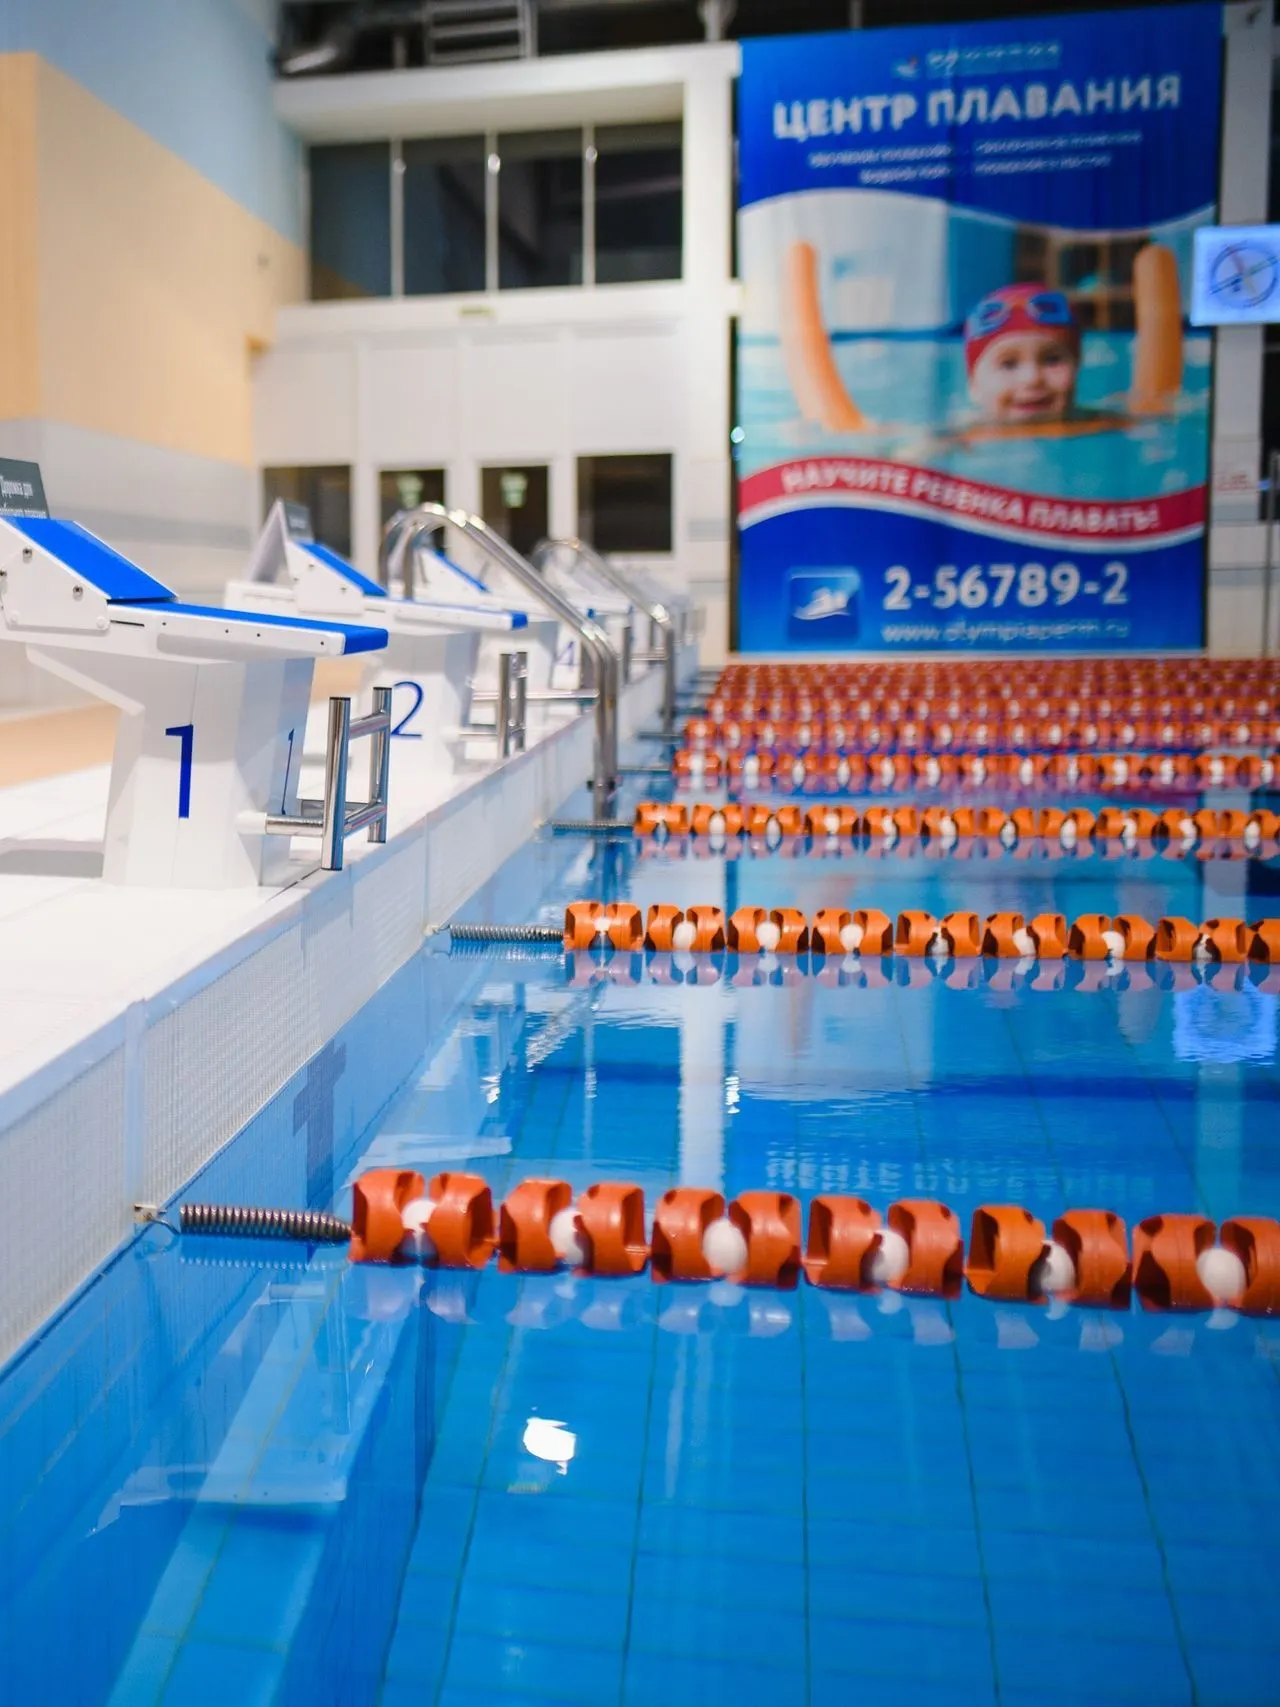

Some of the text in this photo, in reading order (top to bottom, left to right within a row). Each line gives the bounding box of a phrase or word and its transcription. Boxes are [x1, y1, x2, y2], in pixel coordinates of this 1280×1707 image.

[773, 92, 917, 142] ЦЕНТР
[926, 73, 1182, 127] ПЛАВАНИЯ
[781, 461, 910, 495] НАУЧИТЕ
[882, 563, 1129, 611] 2-56789-2
[390, 680, 425, 741] 2
[165, 723, 194, 820] 1
